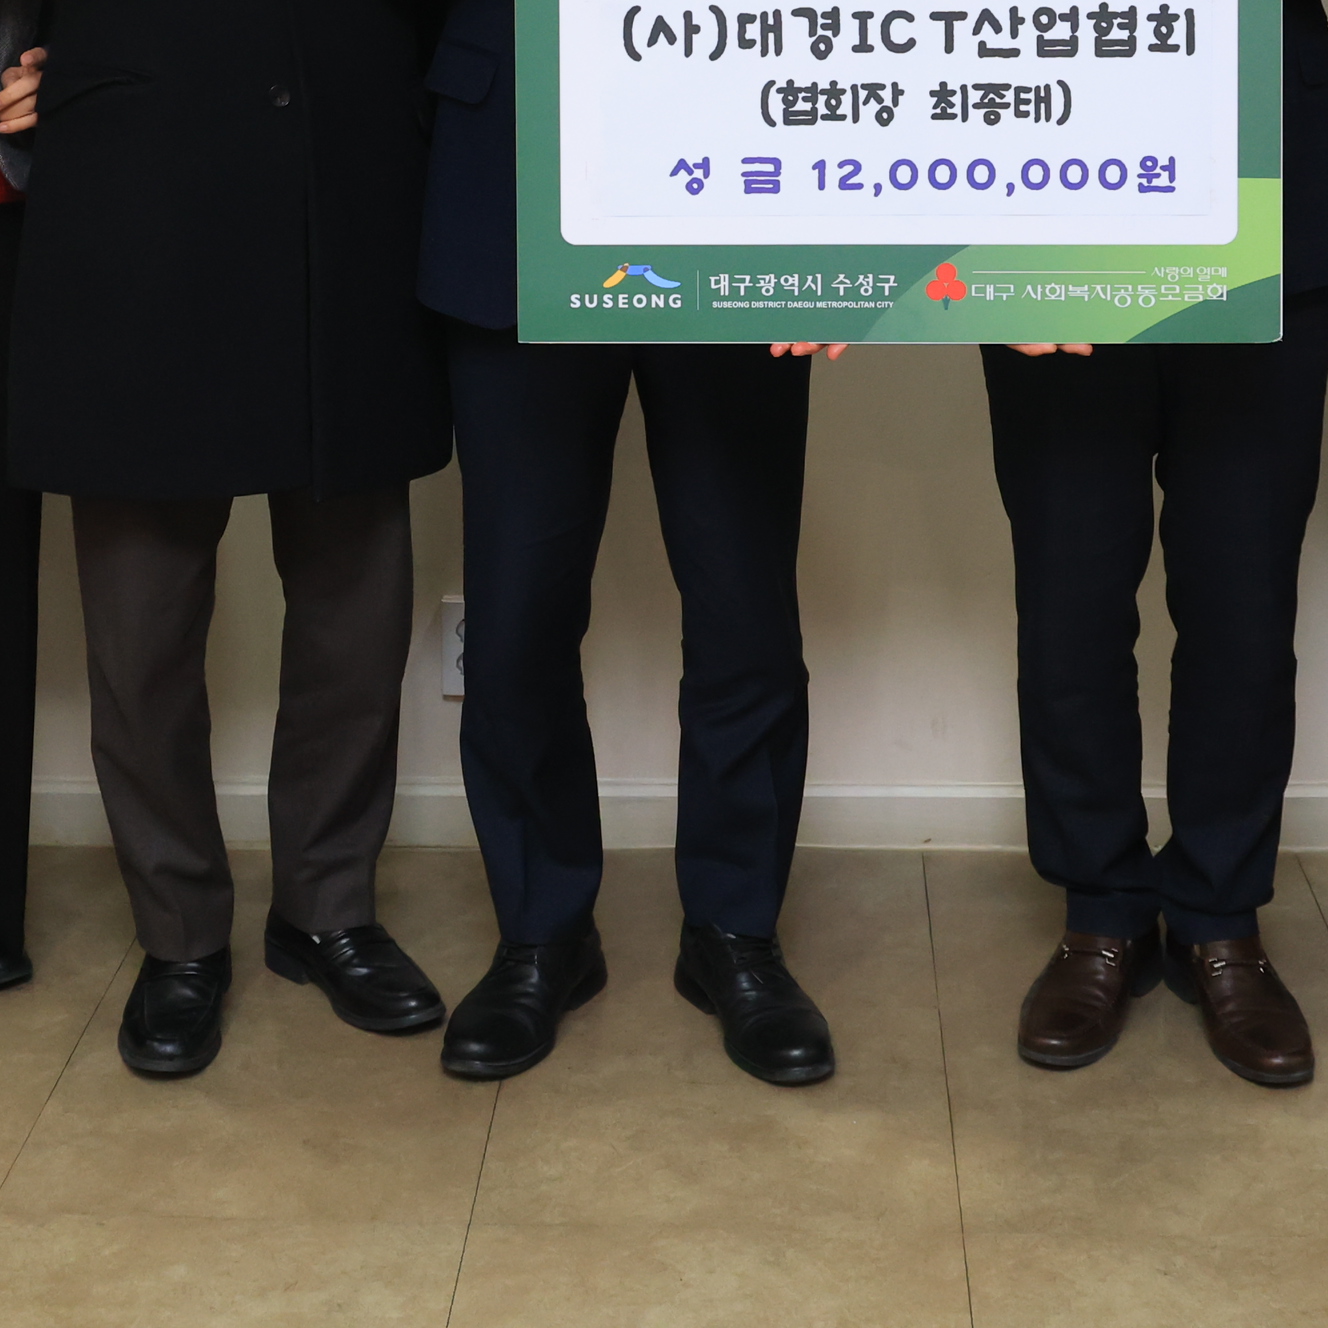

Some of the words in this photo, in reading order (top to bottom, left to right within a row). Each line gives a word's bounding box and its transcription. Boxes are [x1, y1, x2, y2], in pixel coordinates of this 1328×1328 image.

[759, 78, 905, 128] (협회장
[929, 79, 1073, 127] 최종태)
[811, 156, 1178, 198] 12,000,000원
[708, 273, 822, 297] 대구광역시
[830, 273, 898, 297] 수성구
[1151, 265, 1193, 282] 사랑의
[1196, 265, 1228, 282] 열매
[570, 293, 683, 309] SUSEONG
[712, 300, 750, 309] SUSEONG
[751, 300, 786, 309] DISTRICT
[787, 300, 814, 309] DAEGU
[816, 300, 875, 309] METROPOLITAN
[876, 300, 894, 309] CITY
[971, 283, 1016, 302] 대구
[1021, 282, 1228, 309] 사회복지공동모금회
